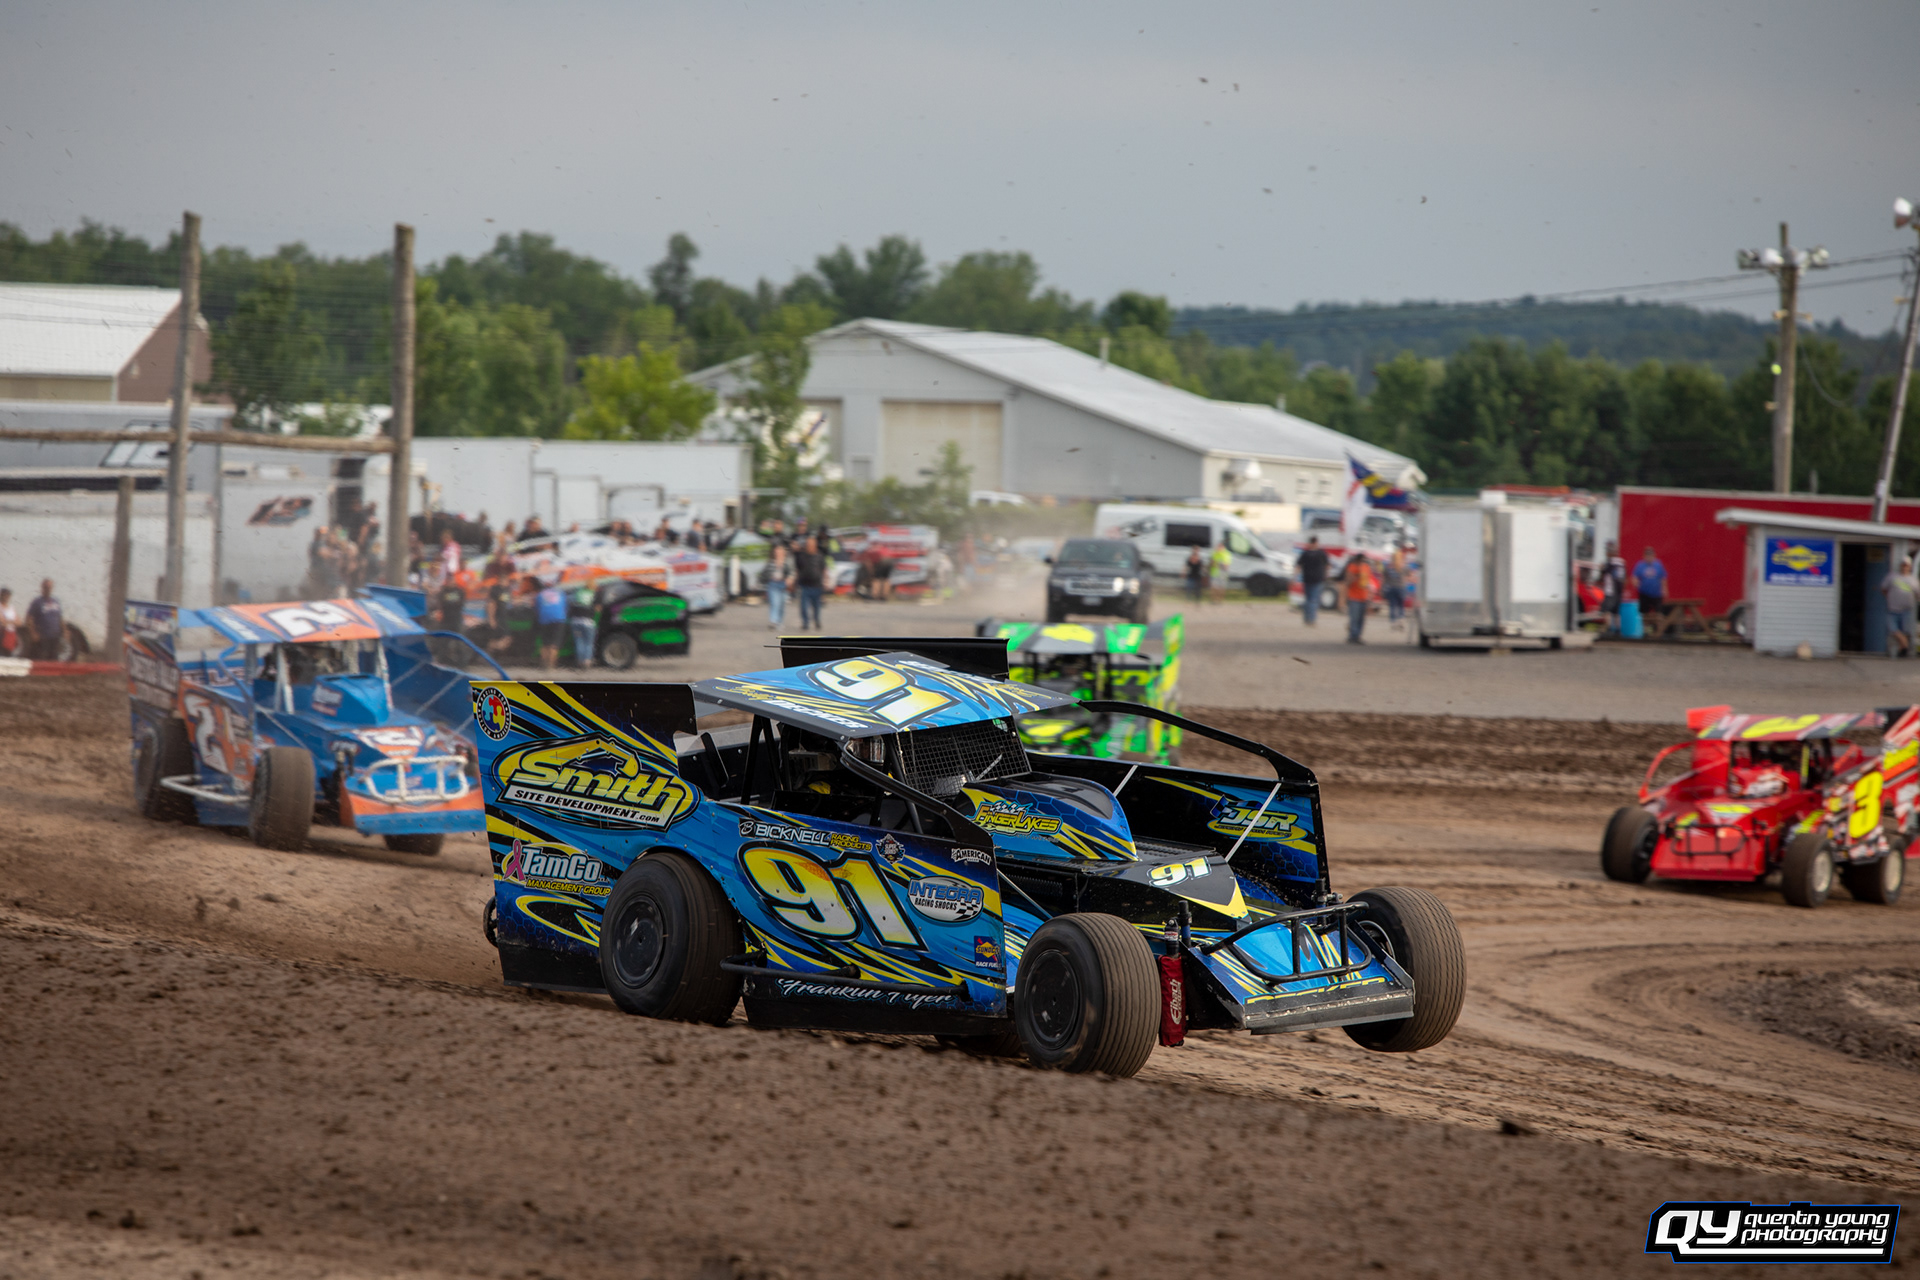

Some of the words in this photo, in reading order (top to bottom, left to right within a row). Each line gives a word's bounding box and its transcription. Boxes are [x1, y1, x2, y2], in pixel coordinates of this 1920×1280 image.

[813, 658, 953, 727] 91
[511, 748, 685, 808] Smith
[514, 790, 545, 801] SITE
[1220, 807, 1298, 832] JSR
[755, 823, 830, 846] BICKNELL
[831, 833, 859, 843] RACING
[831, 840, 872, 851] PRODUCTS
[522, 848, 602, 882] TamCo
[955, 849, 991, 864] AMERICAN
[1150, 857, 1209, 886] 91
[527, 879, 583, 894] MANAGEMENT
[583, 885, 611, 897] GROUP
[740, 844, 922, 949] 91
[910, 880, 981, 904] INTEGRA
[914, 897, 933, 908] RACING
[935, 901, 957, 911] SHOCKS
